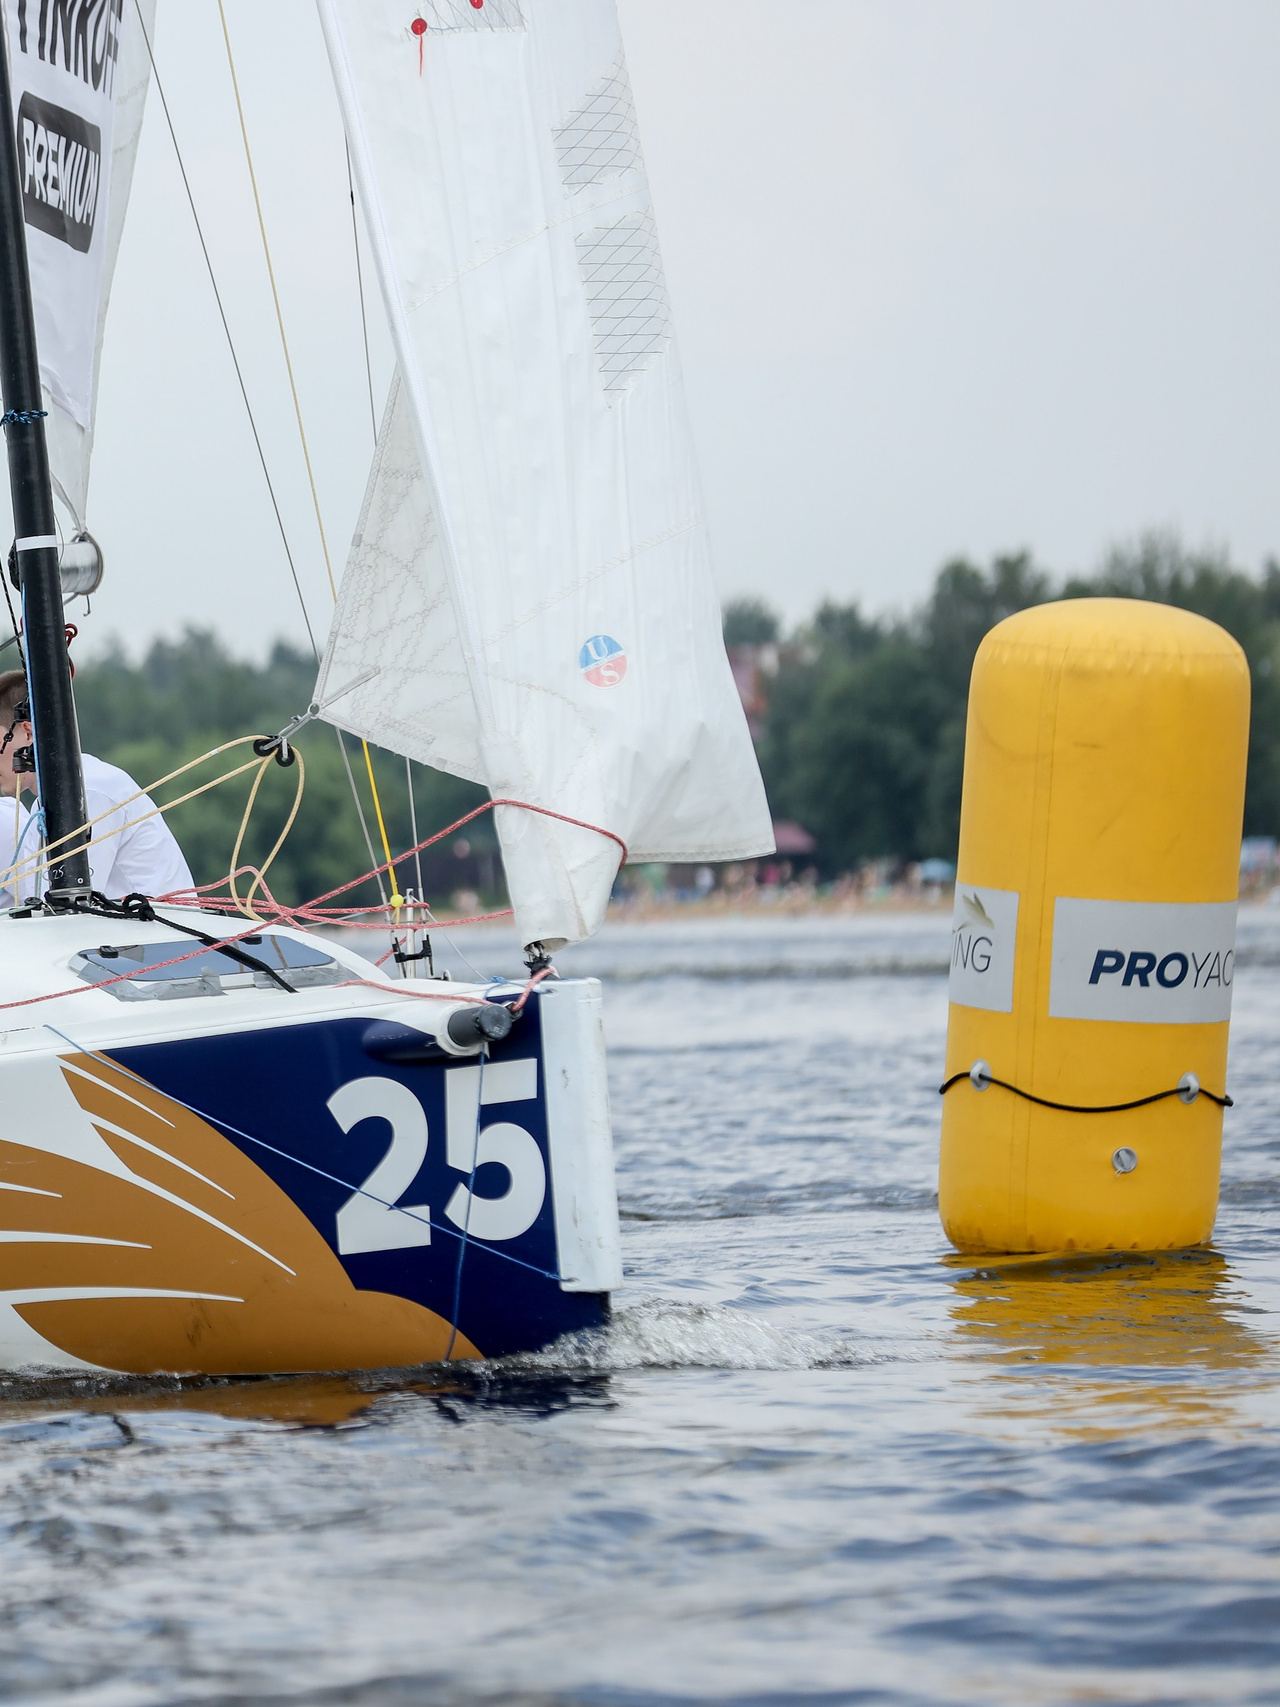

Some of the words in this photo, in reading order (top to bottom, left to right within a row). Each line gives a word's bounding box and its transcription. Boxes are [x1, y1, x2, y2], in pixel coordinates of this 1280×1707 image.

[22, 116, 99, 227] PREMIUM
[52, 864, 65, 880] 25
[951, 931, 993, 973] ING
[1087, 948, 1235, 989] PROYAC
[325, 1057, 546, 1256] 25
